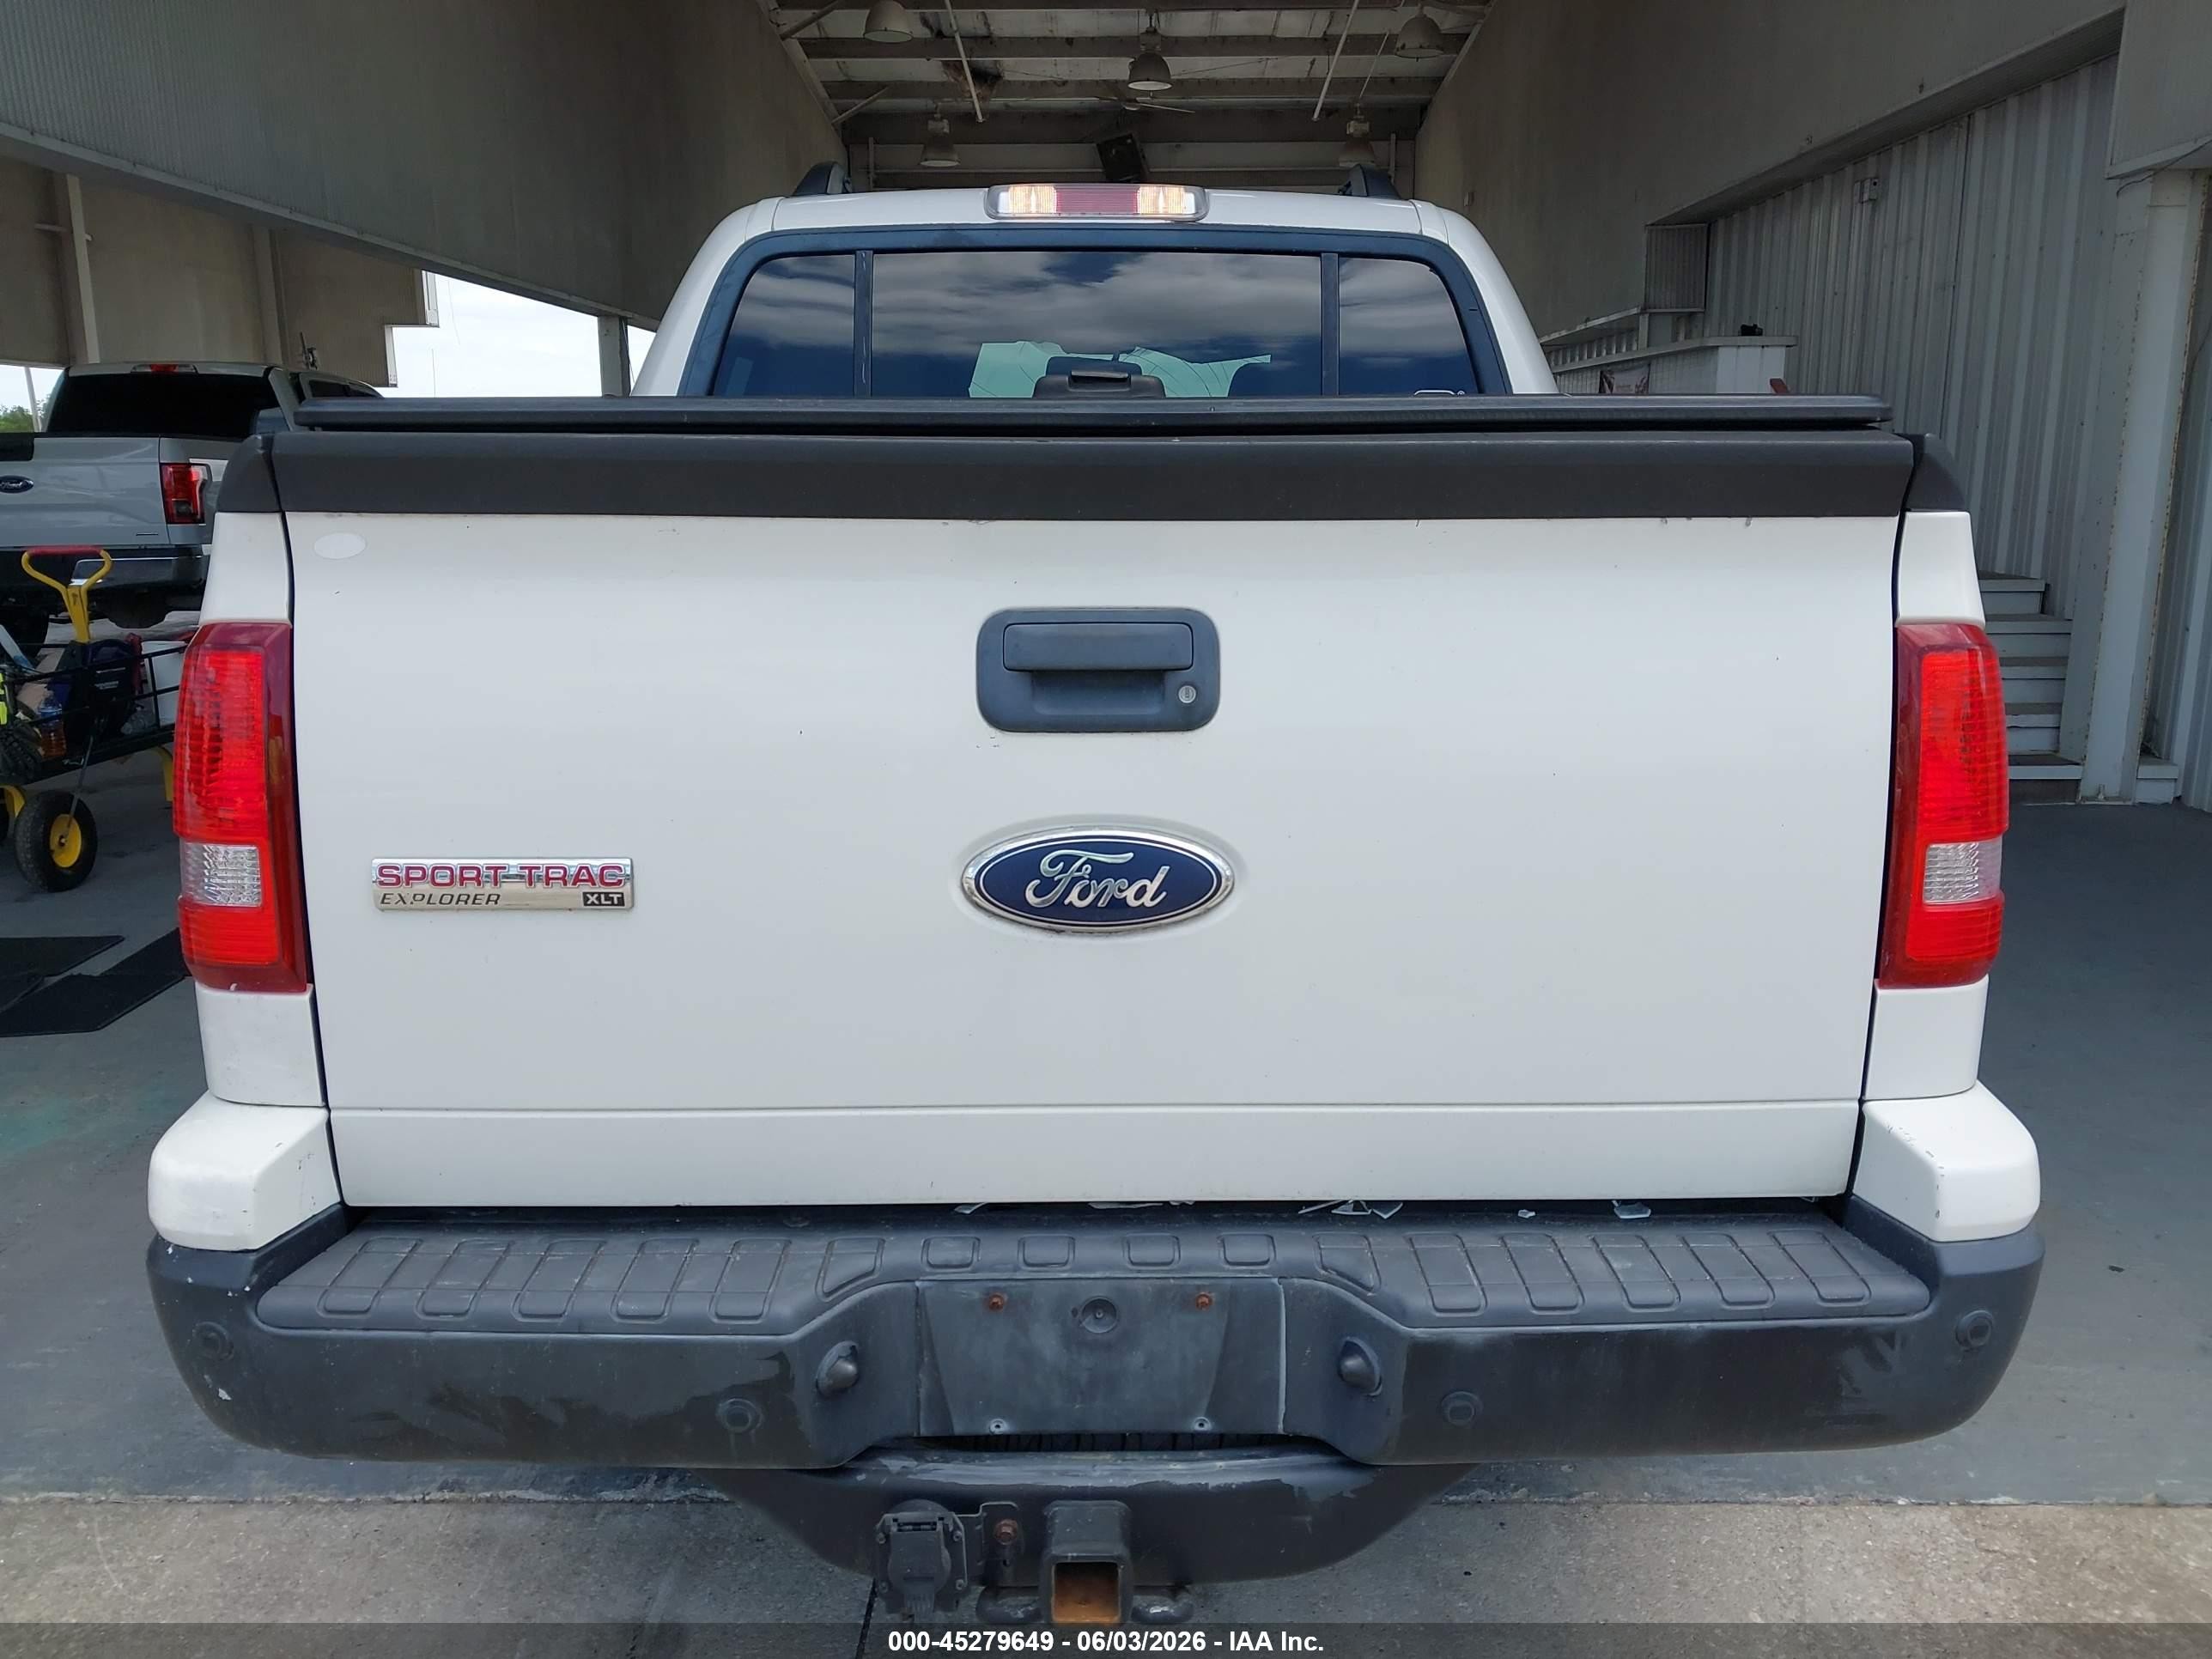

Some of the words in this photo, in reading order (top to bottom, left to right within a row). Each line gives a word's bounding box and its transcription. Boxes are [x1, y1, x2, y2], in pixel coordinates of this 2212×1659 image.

[376, 863, 507, 888] SPORT
[517, 863, 626, 888] TRAC
[1025, 849, 1170, 908] Ford
[380, 893, 501, 906] EXPLORER
[585, 892, 624, 905] XLT
